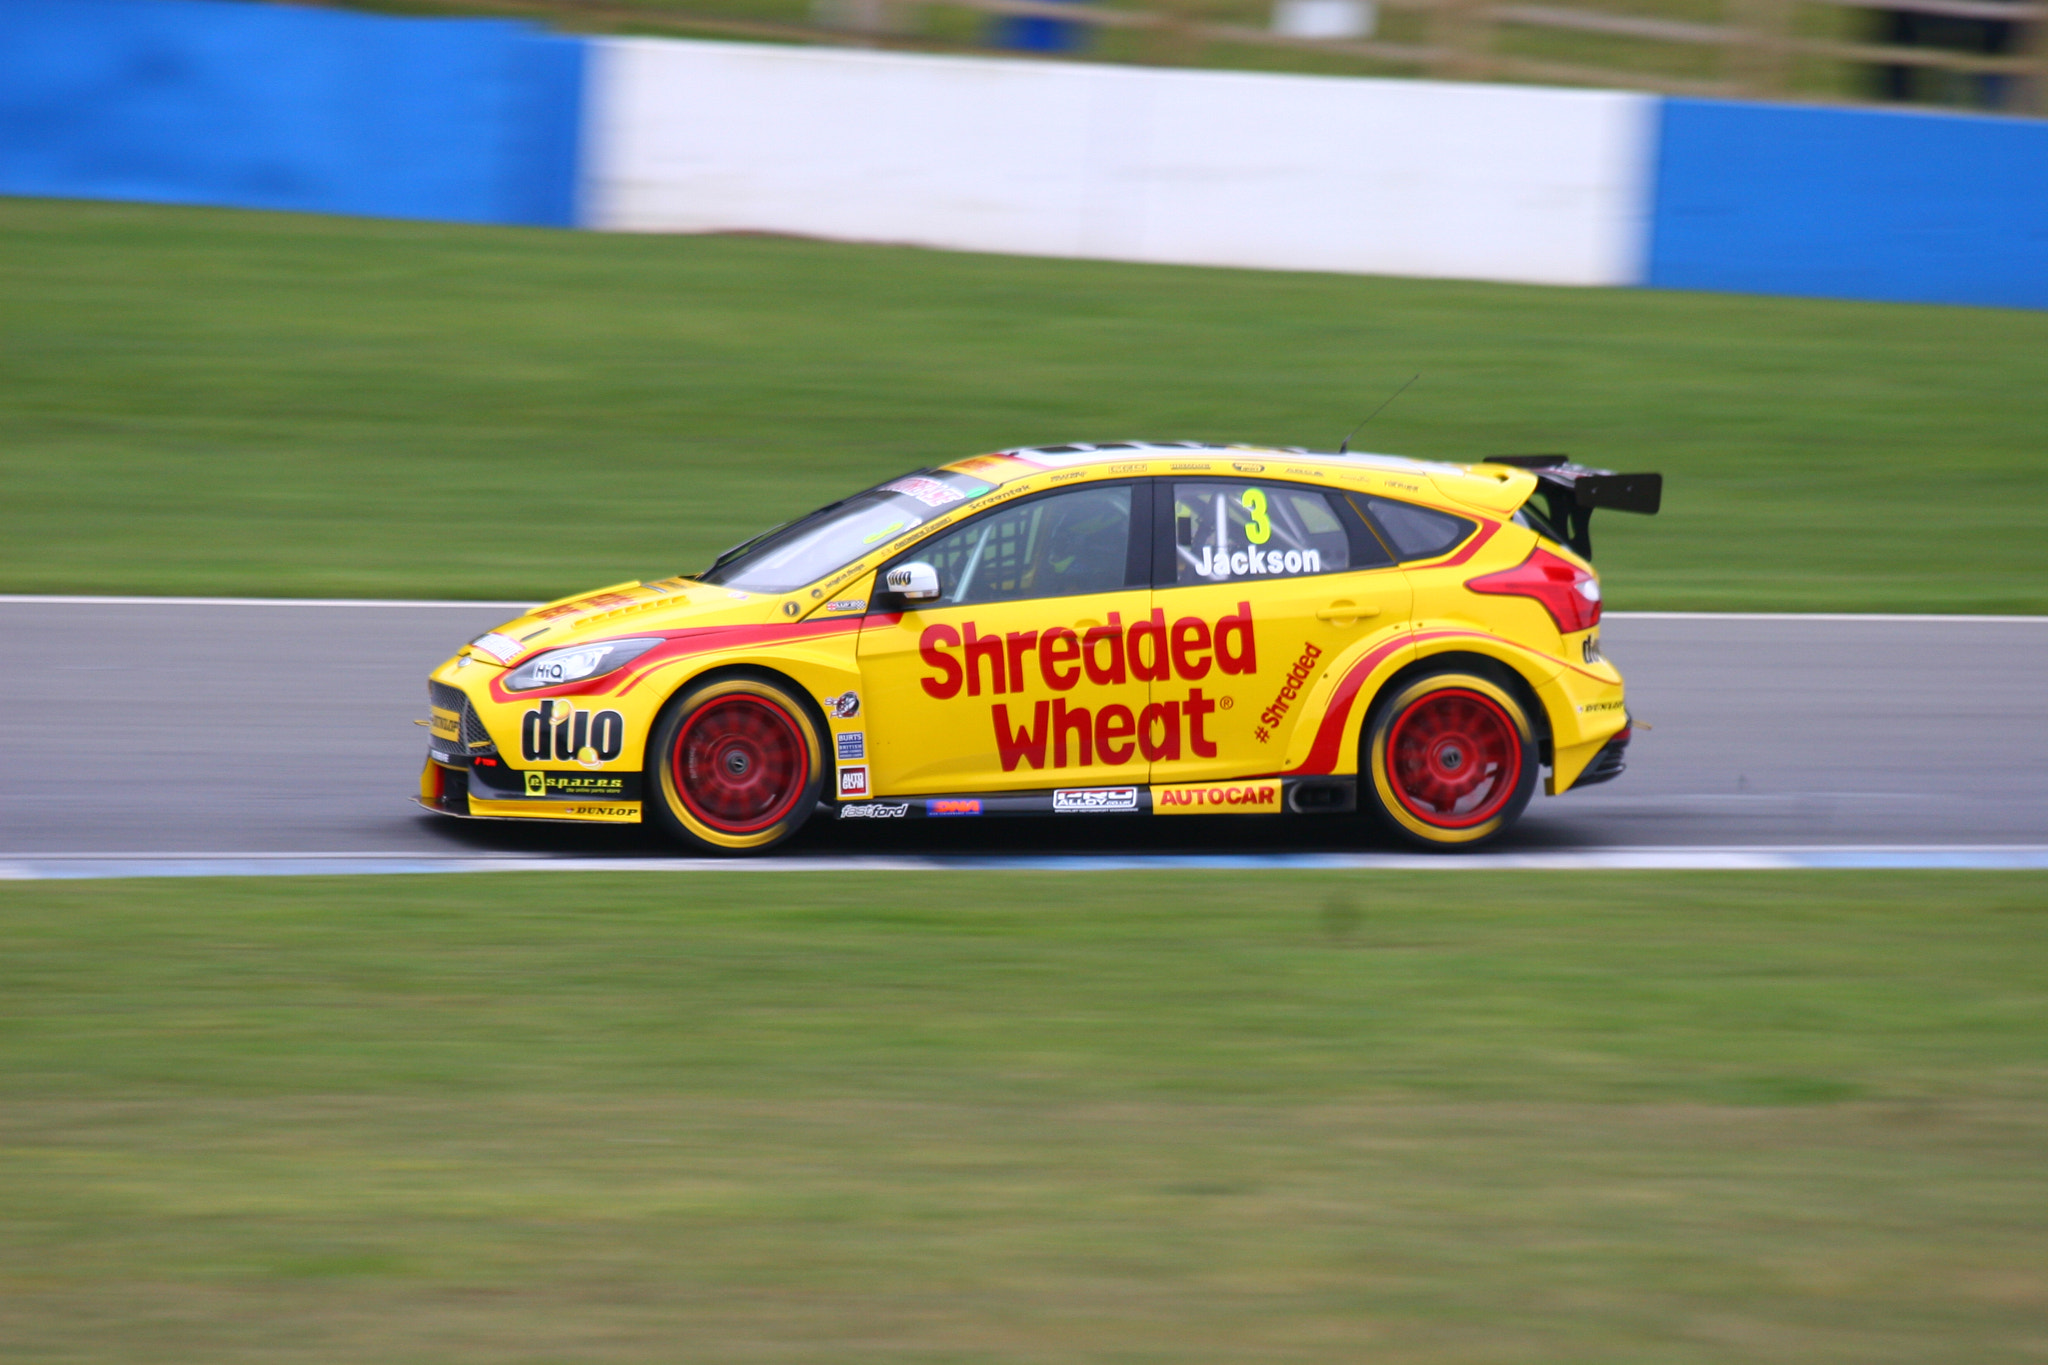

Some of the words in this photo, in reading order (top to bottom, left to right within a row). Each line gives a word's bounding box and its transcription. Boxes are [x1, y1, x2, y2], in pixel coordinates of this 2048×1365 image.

[1241, 488, 1272, 545] 3
[1195, 545, 1321, 576] Jackson
[919, 601, 1257, 700] Shredded
[535, 664, 563, 679] HiQ
[1254, 641, 1323, 744] #Shredded
[522, 699, 624, 762] duo
[991, 688, 1218, 773] Wheat
[842, 772, 864, 782] AUTO
[842, 781, 865, 790] GLYM
[576, 807, 638, 816] DUNLOP
[1160, 787, 1275, 806] AUTOCAR
